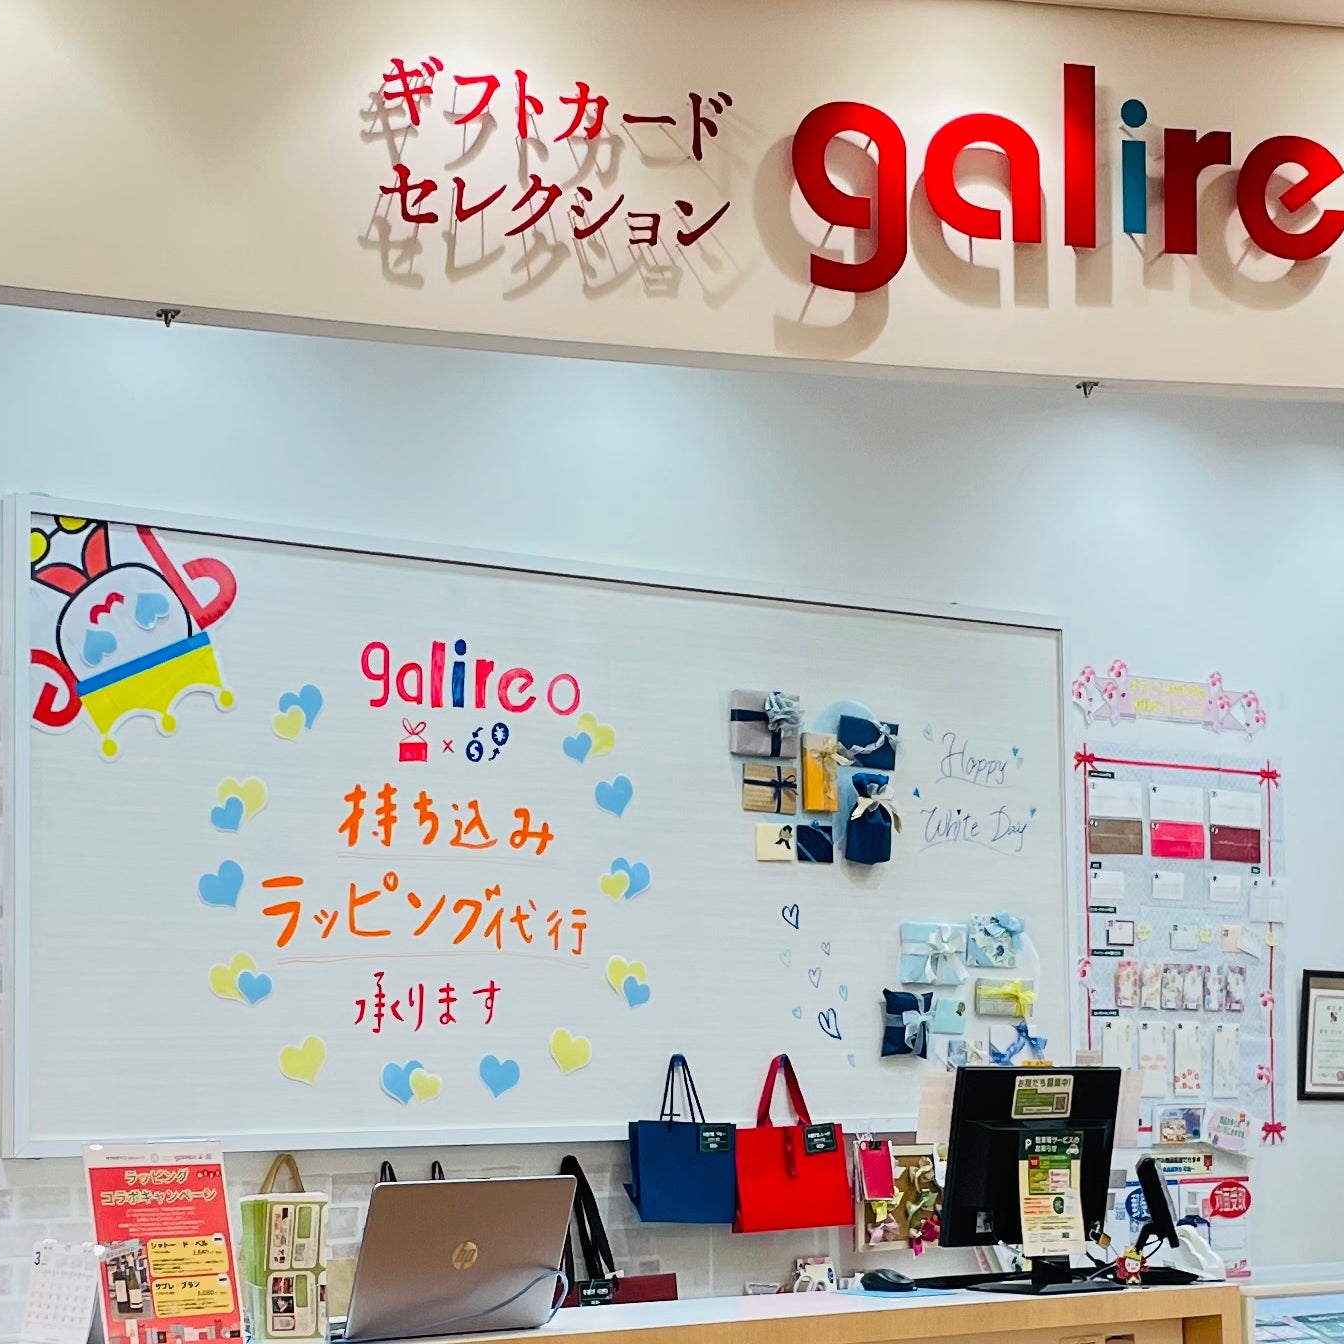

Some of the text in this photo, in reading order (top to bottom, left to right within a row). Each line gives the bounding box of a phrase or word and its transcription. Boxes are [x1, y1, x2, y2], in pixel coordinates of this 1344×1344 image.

[382, 56, 733, 160] ギフトカード
[379, 164, 730, 247] セレクション
[361, 639, 581, 716] galireo
[941, 732, 1009, 784] Happy
[338, 782, 554, 855] 持ち込み
[920, 805, 1029, 852] White Day
[262, 871, 588, 955] ラッピング代行
[355, 971, 502, 1034] 承ります
[100, 1187, 217, 1206] コラボキャンペーン
[124, 1167, 190, 1186] ラッピング
